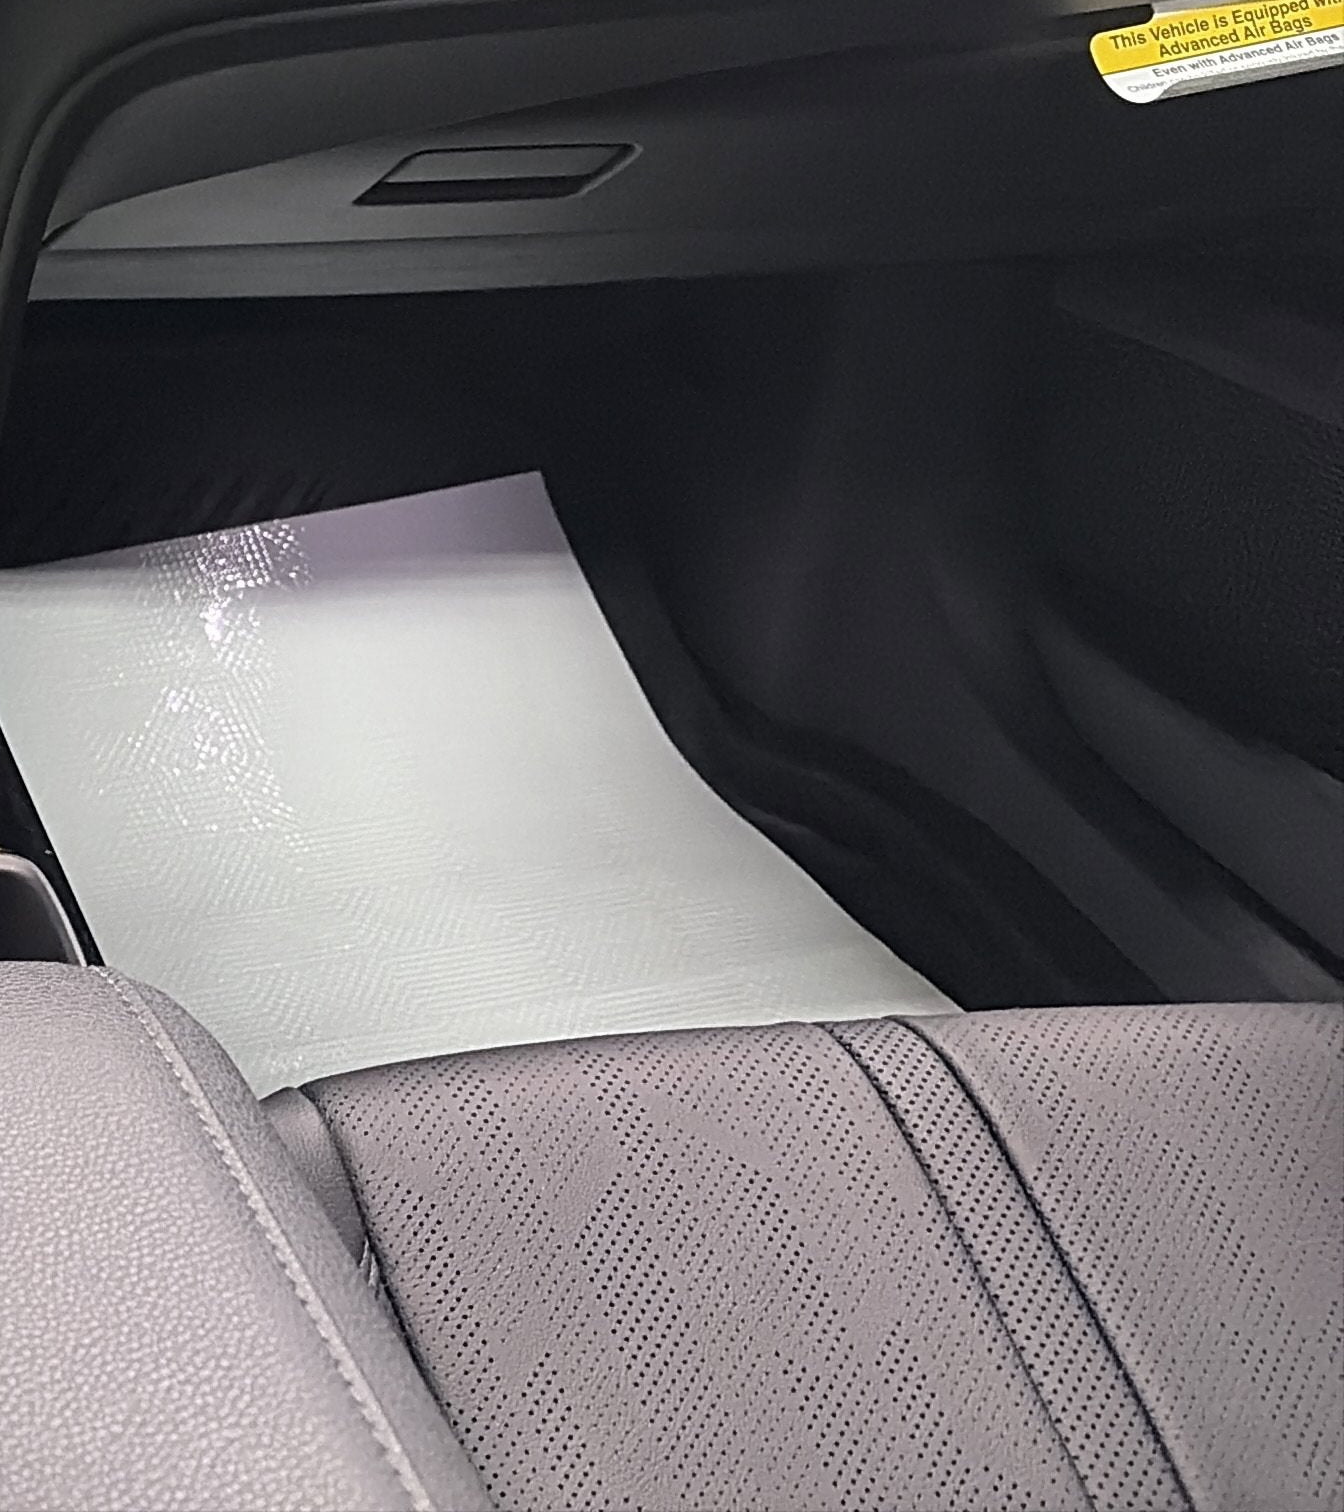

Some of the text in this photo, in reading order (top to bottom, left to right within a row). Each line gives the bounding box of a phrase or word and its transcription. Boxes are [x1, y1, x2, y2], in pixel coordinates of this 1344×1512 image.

[1110, 31, 1147, 50] This
[1149, 19, 1210, 42] Vehicle
[1214, 14, 1229, 29] is
[1159, 15, 1313, 58] Advanced Air Bags
[1152, 32, 1340, 78] Even with Advanced Air Bags
